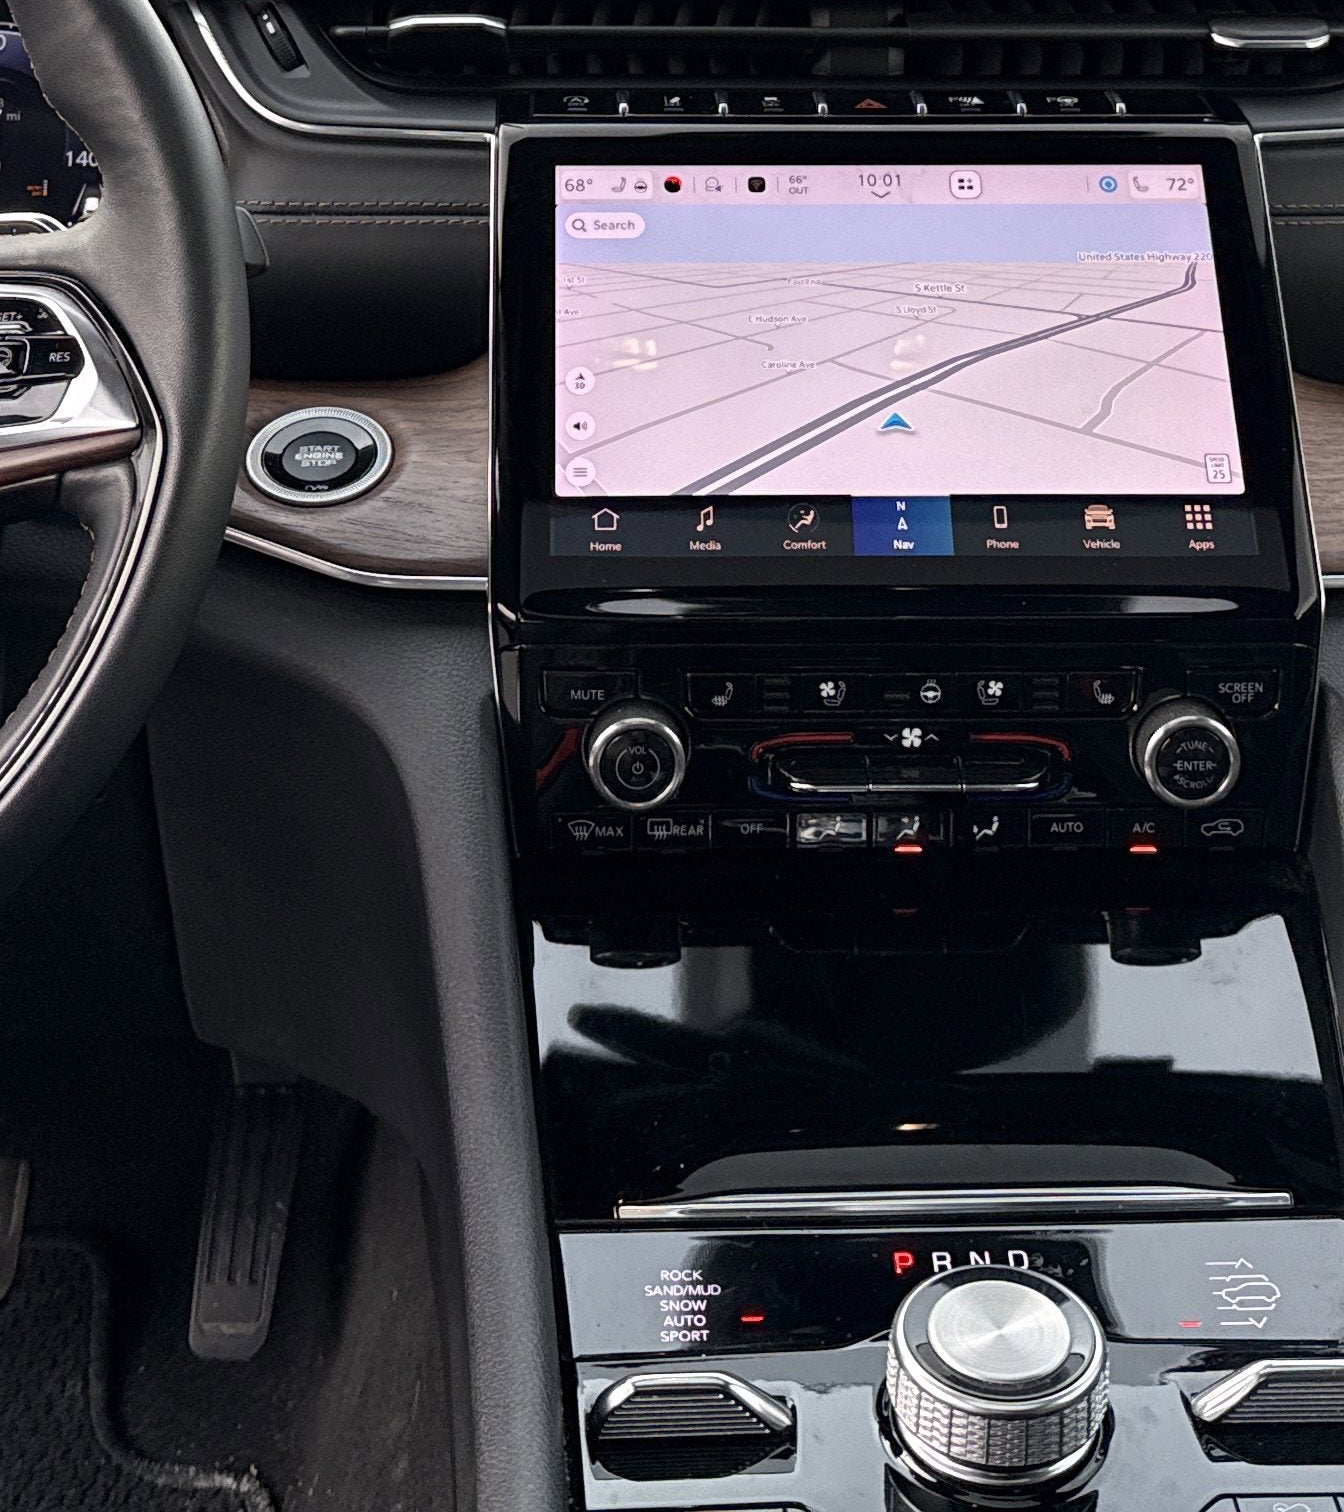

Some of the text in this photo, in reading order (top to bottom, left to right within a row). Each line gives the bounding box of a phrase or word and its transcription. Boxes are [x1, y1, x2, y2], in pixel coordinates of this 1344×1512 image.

[6, 110, 21, 121] mi
[64, 149, 99, 168] 140
[564, 177, 594, 193] 68°
[788, 174, 808, 185] 66°
[857, 173, 902, 187] 10:01
[1165, 176, 1195, 191] 72°
[788, 186, 809, 195] OUT
[593, 219, 636, 231] Search
[1078, 252, 1112, 262] United
[1114, 252, 1146, 262] States
[1147, 252, 1192, 264] Highway
[923, 283, 952, 292] Kettle
[955, 283, 966, 292] St
[48, 351, 71, 364] RES
[799, 360, 816, 369] Ave
[294, 451, 344, 461] ENGINE
[1212, 469, 1226, 480] 25
[896, 500, 906, 511] N
[589, 541, 622, 552] Home
[689, 540, 722, 551] Media
[783, 539, 827, 551] Comfort
[893, 538, 915, 550] Nav
[986, 538, 1020, 550] Phone
[1082, 538, 1121, 550] Vehicle
[1188, 539, 1215, 553] Apps
[1217, 682, 1264, 694] SCREEN
[570, 689, 605, 701] MUTE
[1232, 693, 1255, 704] OFF
[629, 745, 648, 756] VOL
[1180, 739, 1208, 751] TUNE
[1176, 760, 1213, 771] ENTER
[595, 826, 624, 837] MAX
[673, 824, 705, 836] REAR
[739, 823, 764, 834] OFF
[1049, 821, 1084, 833] AUTO
[1132, 822, 1156, 834] A/C
[894, 1249, 1029, 1274] P R N D
[659, 1269, 704, 1282] ROCK
[643, 1284, 722, 1297] SAND/MUD
[659, 1299, 708, 1312] SNOW
[662, 1315, 707, 1327] AUTO
[659, 1330, 710, 1343] SPORT
